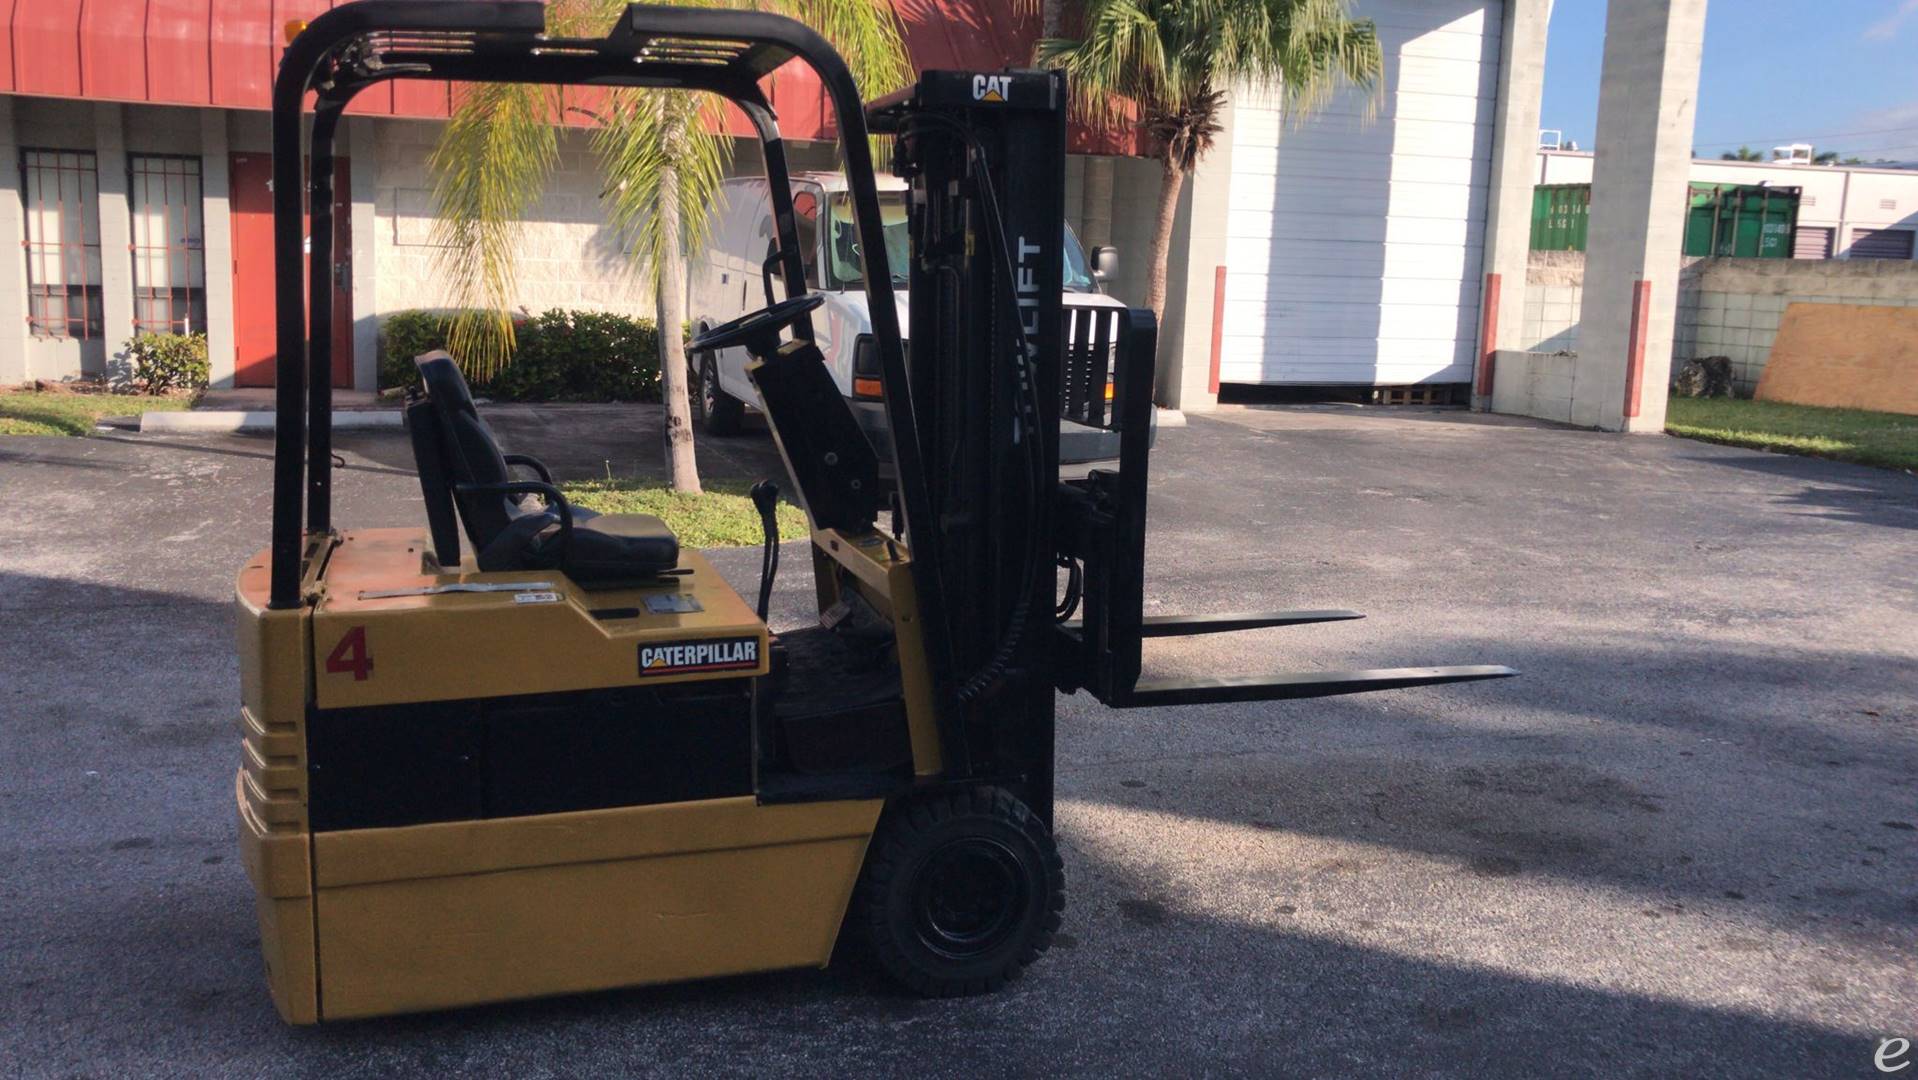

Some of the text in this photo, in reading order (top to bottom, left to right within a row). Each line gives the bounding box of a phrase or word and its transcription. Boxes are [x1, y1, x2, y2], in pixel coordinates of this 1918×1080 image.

[973, 74, 1012, 101] CAT
[325, 625, 375, 682] 4
[641, 641, 757, 669] CATERPILLAR
